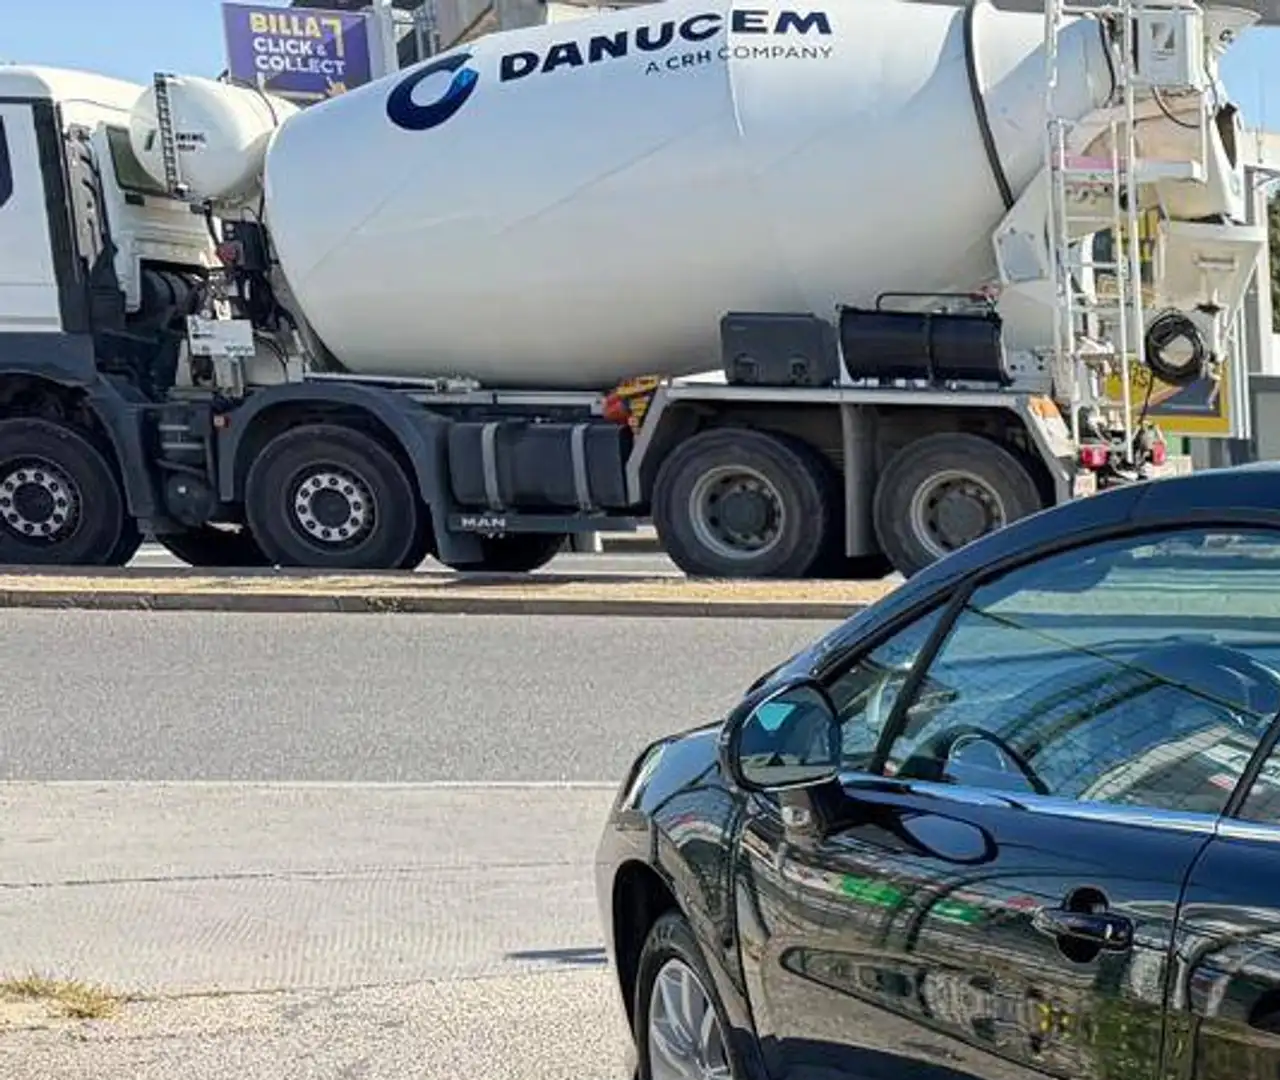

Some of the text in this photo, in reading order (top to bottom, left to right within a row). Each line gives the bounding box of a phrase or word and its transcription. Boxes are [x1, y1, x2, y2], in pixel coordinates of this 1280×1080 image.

[250, 12, 321, 38] BILLA
[253, 36, 312, 56] CLICK
[499, 9, 833, 82] DANUCEM
[255, 55, 345, 75] COLLECT
[644, 45, 833, 75] A CRH COMPANY
[461, 517, 505, 527] MAN
